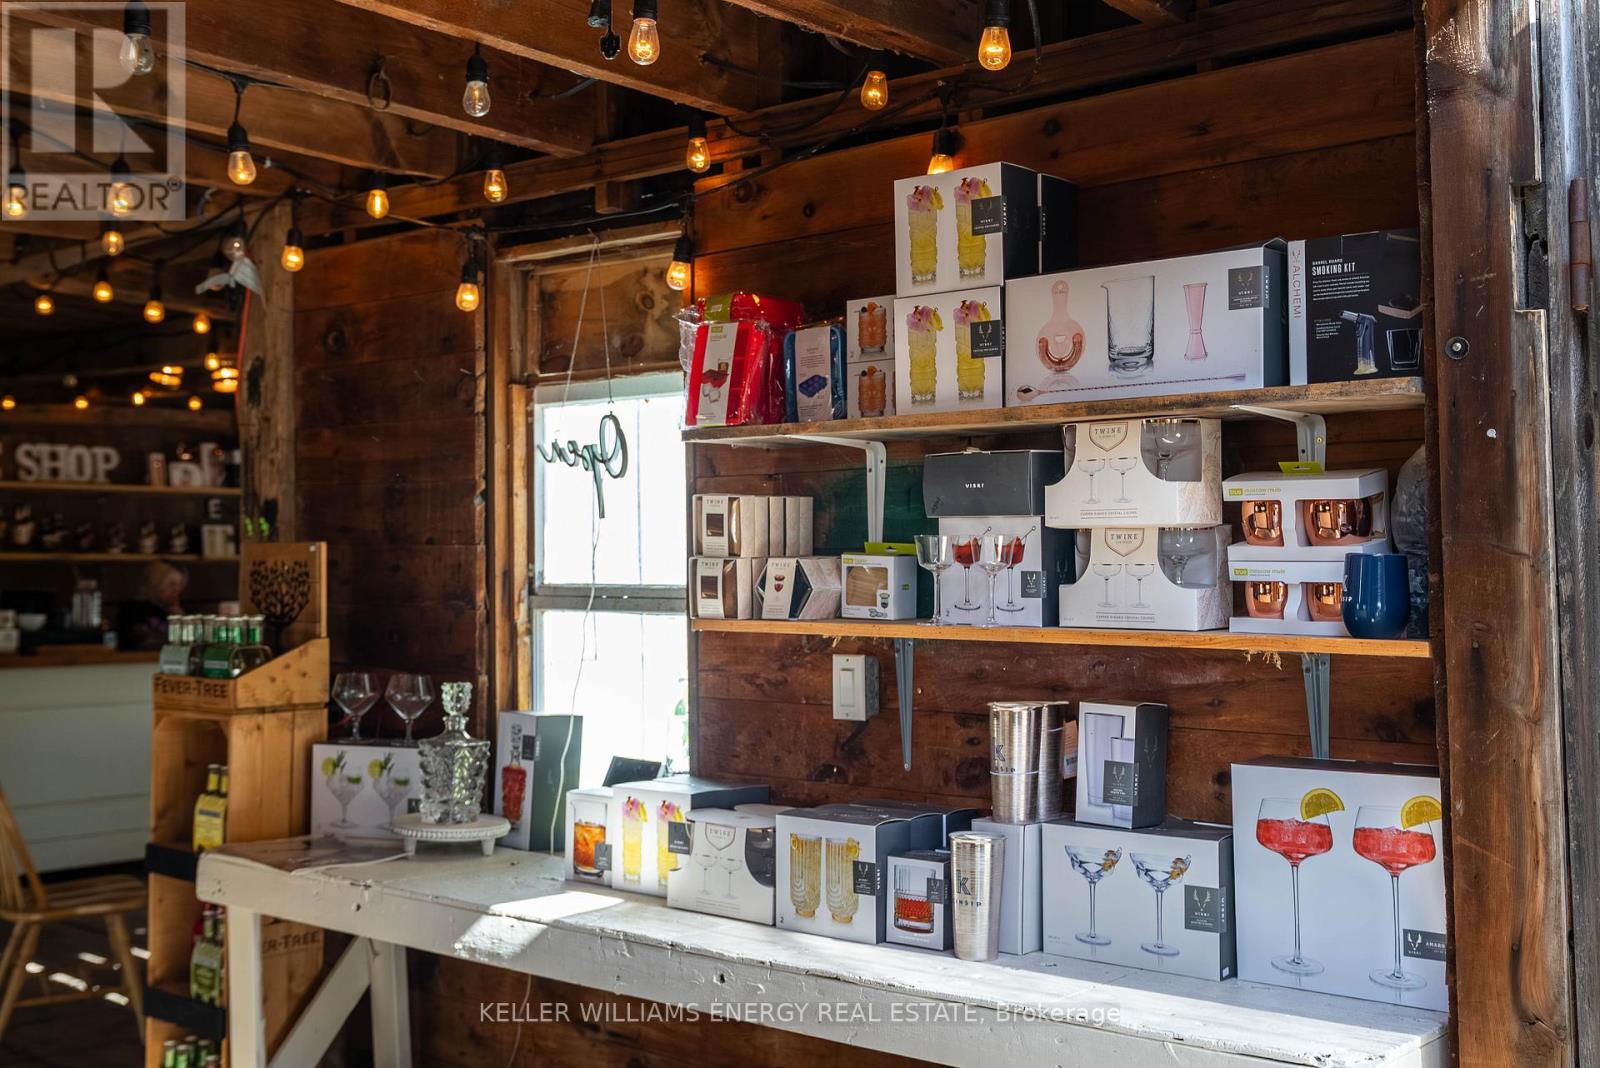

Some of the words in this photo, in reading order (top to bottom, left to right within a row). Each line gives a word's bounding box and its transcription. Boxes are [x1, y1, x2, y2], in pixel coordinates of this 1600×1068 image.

[1312, 263, 1342, 276] SMOKING
[1343, 262, 1356, 273] KIT
[1094, 426, 1122, 435] TWINE
[15, 443, 121, 484] SHOP
[1110, 533, 1138, 541] TWINE
[262, 930, 321, 951] R-TREE
